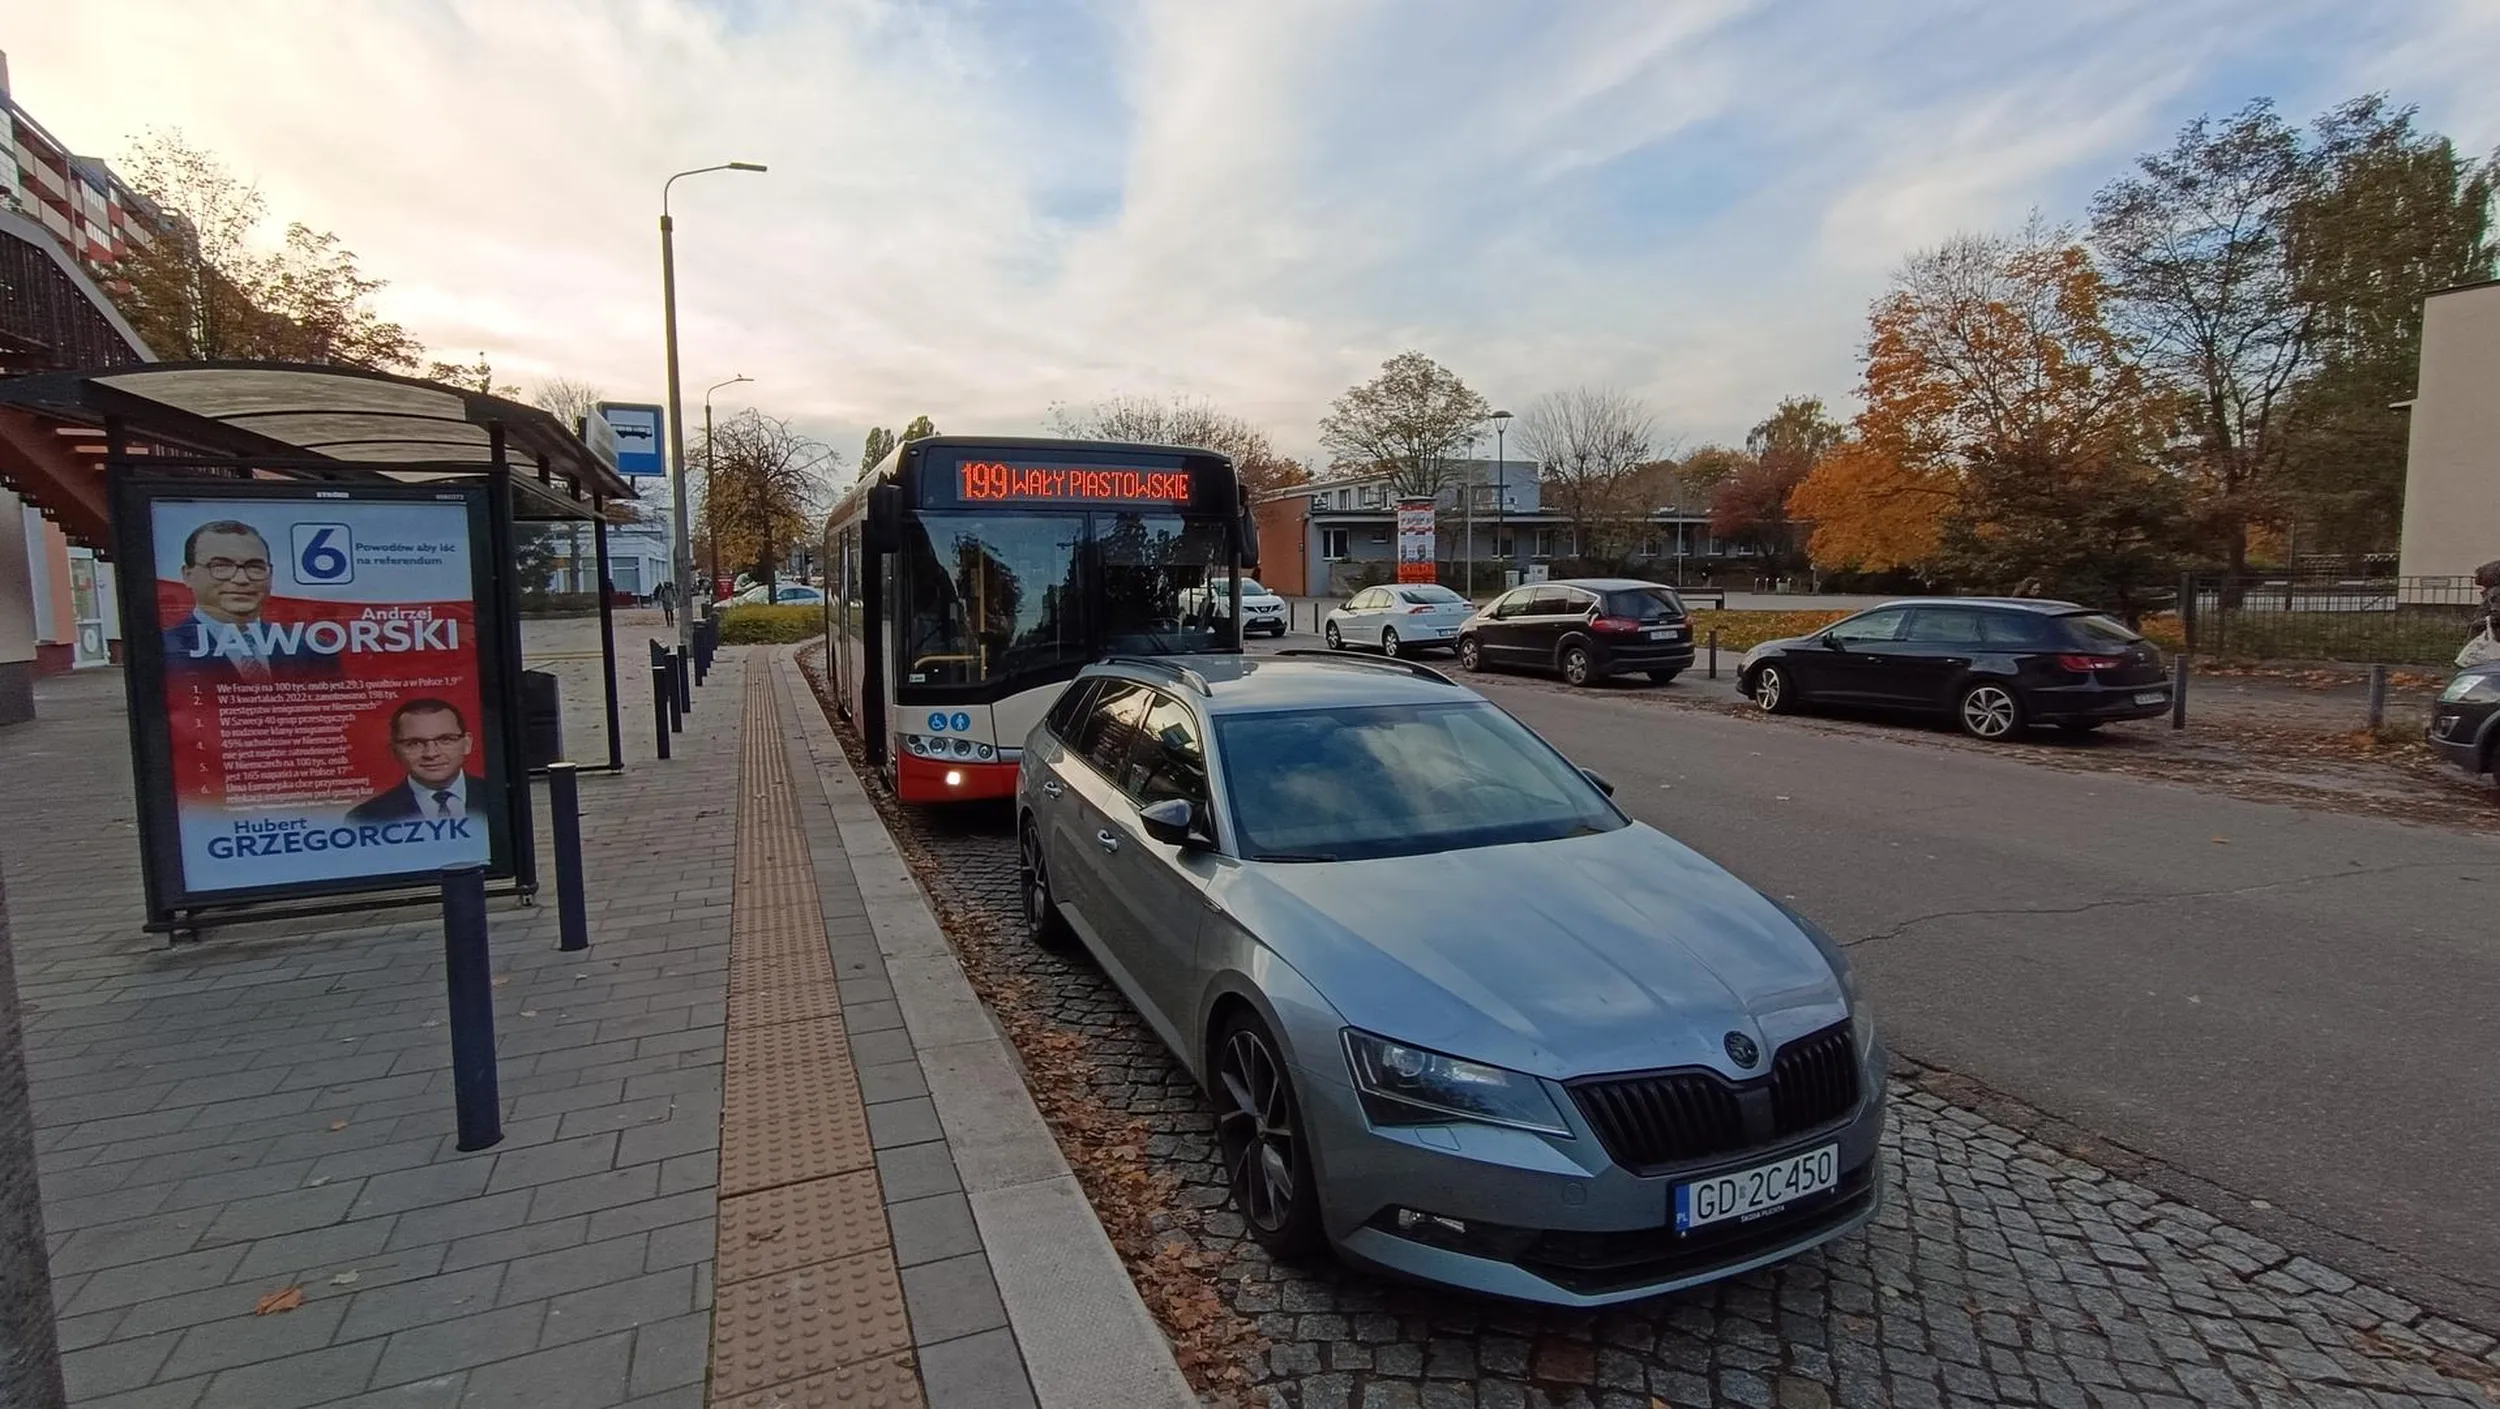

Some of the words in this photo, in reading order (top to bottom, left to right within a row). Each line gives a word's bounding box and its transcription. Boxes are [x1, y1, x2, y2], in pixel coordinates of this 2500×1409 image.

[961, 462, 1008, 499] 199
[1011, 468, 1066, 496] WAŁY
[1069, 470, 1190, 500] PIASTOWSKIE
[301, 528, 348, 579] 6
[355, 541, 415, 553] Powodów
[416, 543, 438, 555] aby
[439, 542, 456, 553] iść
[356, 557, 371, 565] na
[373, 555, 443, 566] referendum
[361, 607, 434, 623] Andrzej
[190, 619, 459, 658] JAWORSKI
[193, 685, 203, 694] 1.
[275, 682, 291, 691] 100
[194, 696, 204, 705] 2.
[217, 695, 228, 704] W
[229, 695, 236, 704] 3
[285, 692, 306, 702] 2022
[219, 717, 230, 726] W
[223, 761, 234, 770] W
[234, 818, 308, 834] Hubert
[207, 817, 471, 860] GRZEGORCZYK
[1696, 1179, 1737, 1219] GD
[1748, 1151, 1832, 1208] 2C450
[1676, 1212, 1689, 1224] PL
